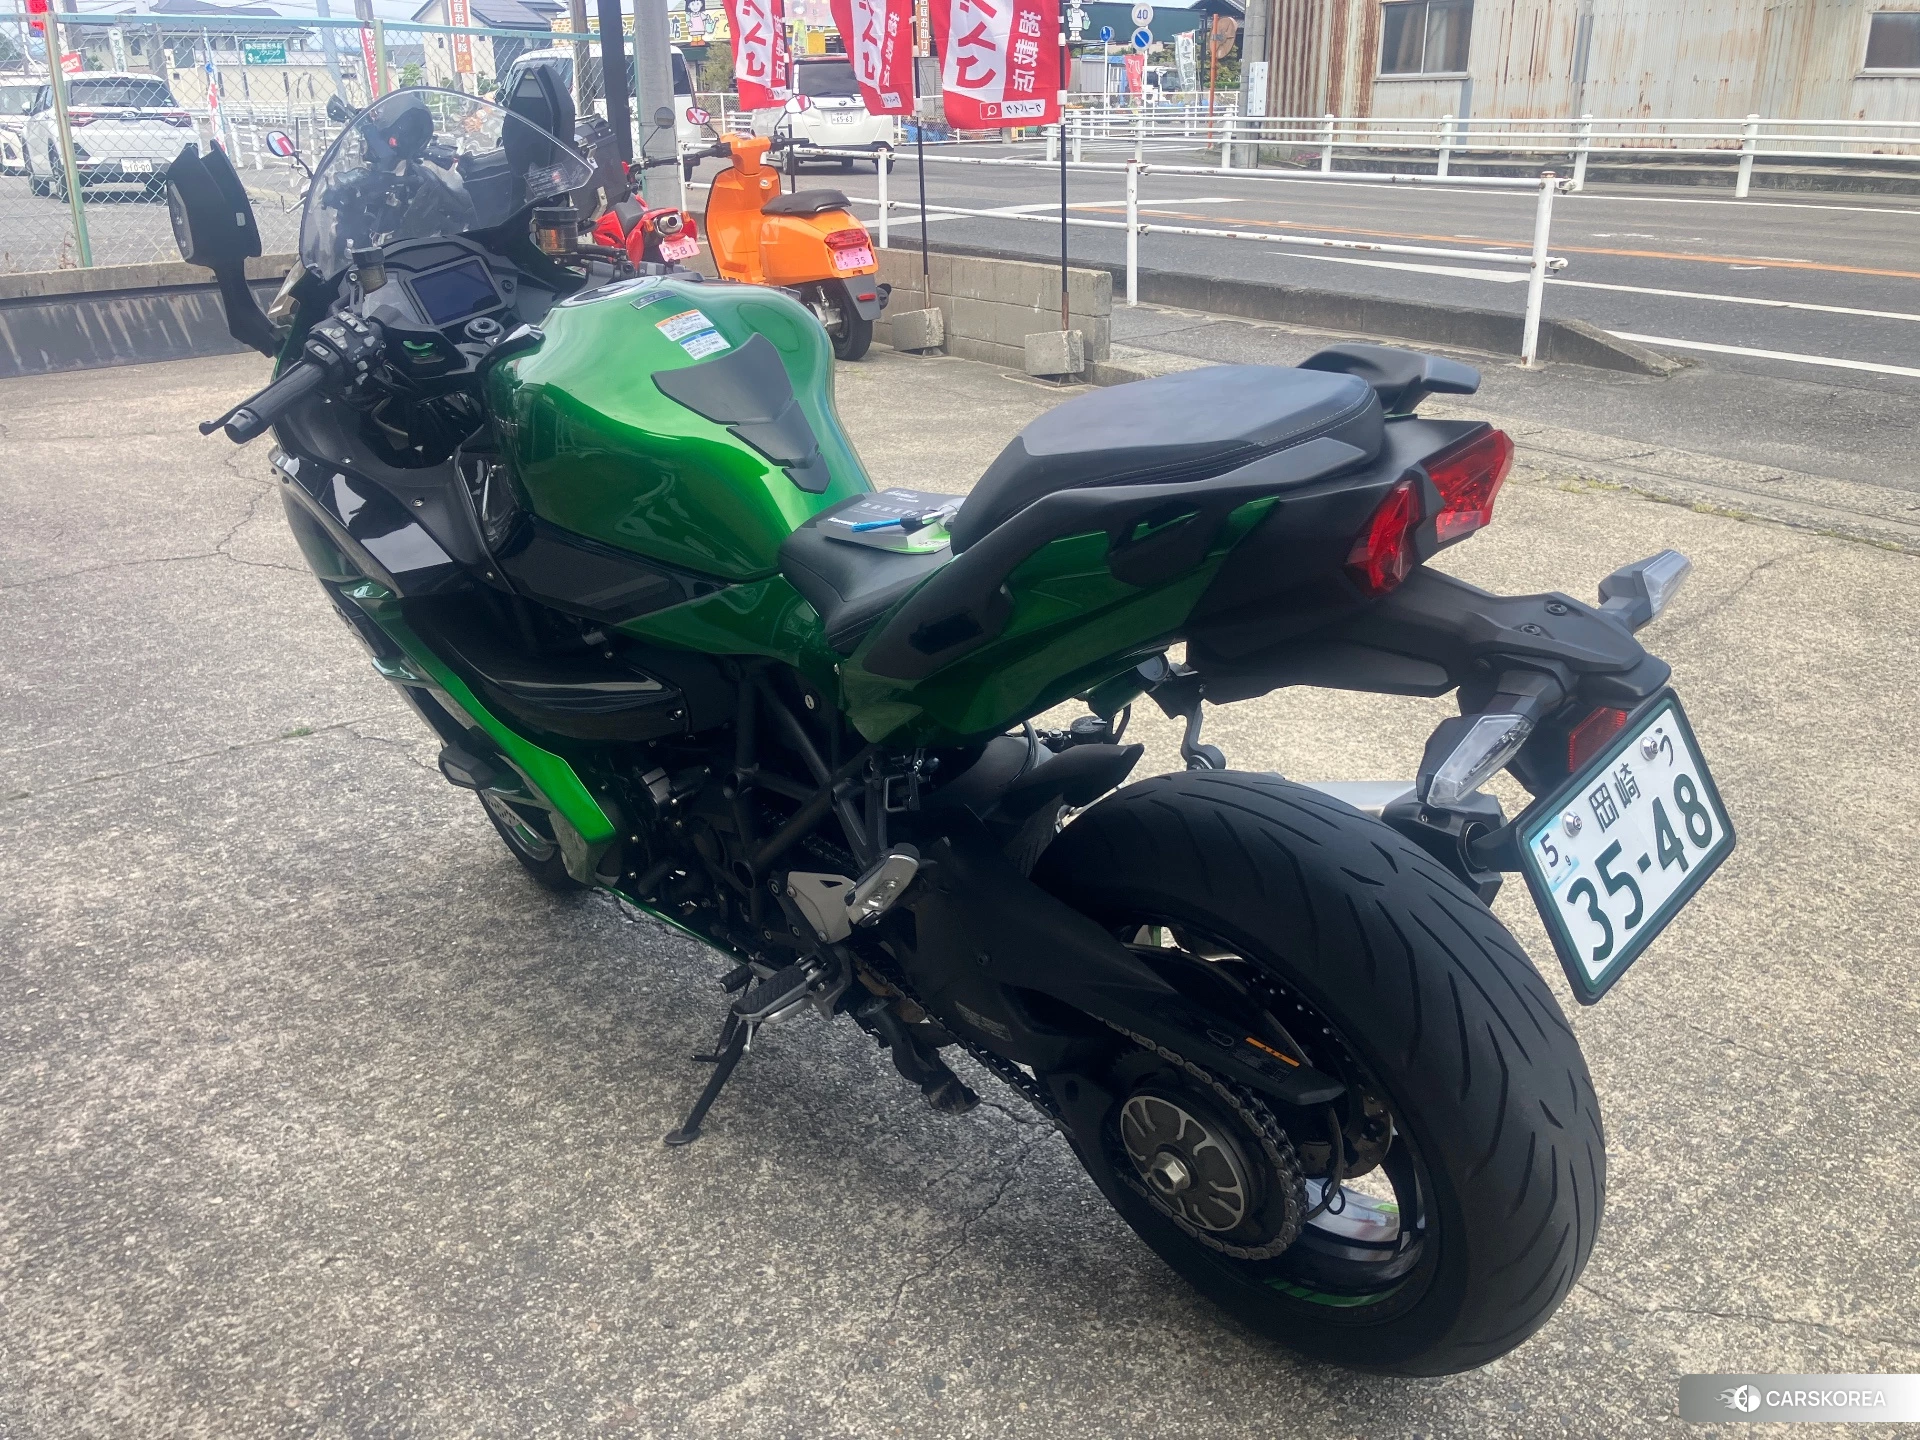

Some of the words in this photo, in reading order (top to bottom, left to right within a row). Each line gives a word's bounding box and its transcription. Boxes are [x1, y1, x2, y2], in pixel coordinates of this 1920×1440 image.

[1137, 9, 1148, 20] 40
[673, 244, 694, 258] 581
[1588, 762, 1640, 833] 岡崎
[1540, 832, 1559, 868] 5
[1566, 773, 1713, 963] 35-48
